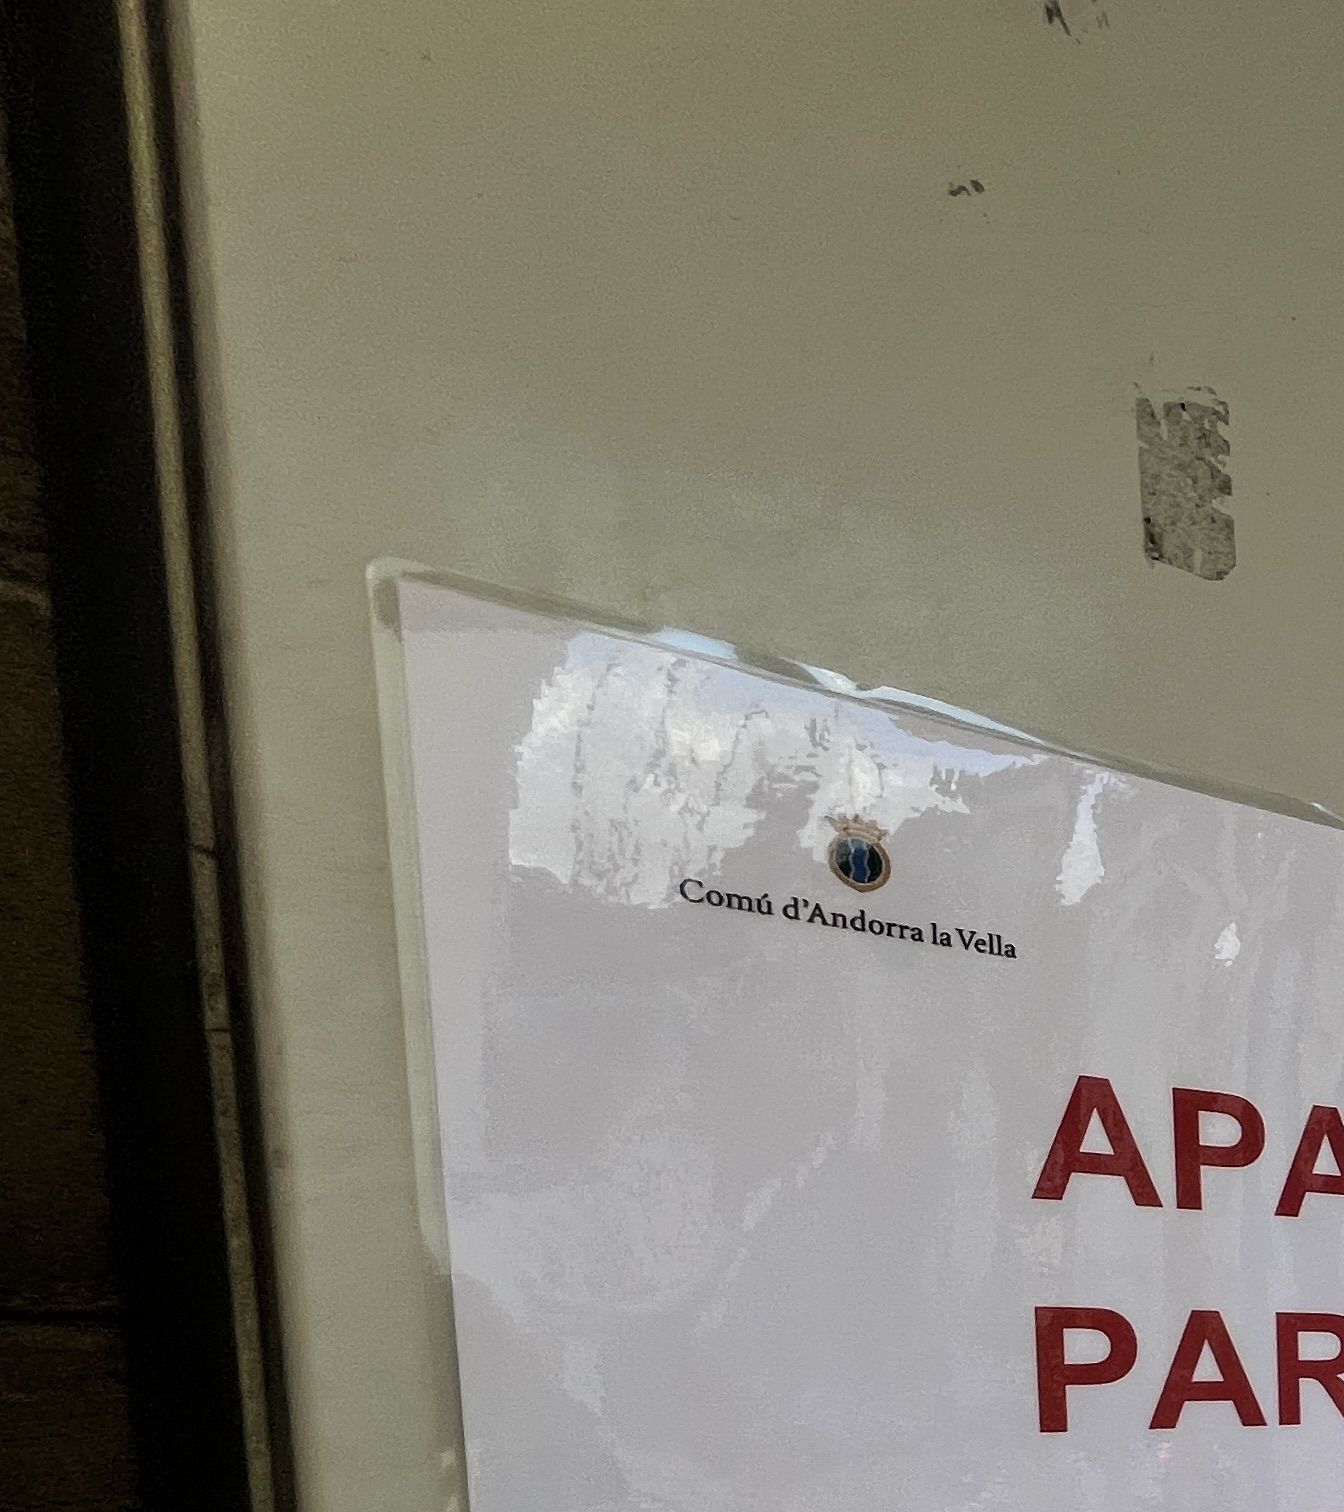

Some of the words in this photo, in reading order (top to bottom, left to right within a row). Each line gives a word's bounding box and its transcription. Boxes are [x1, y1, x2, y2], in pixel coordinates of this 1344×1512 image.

[680, 878, 774, 916] Comú
[782, 896, 925, 943] d'Andorra
[931, 922, 953, 948] la
[956, 928, 1018, 960] Vella
